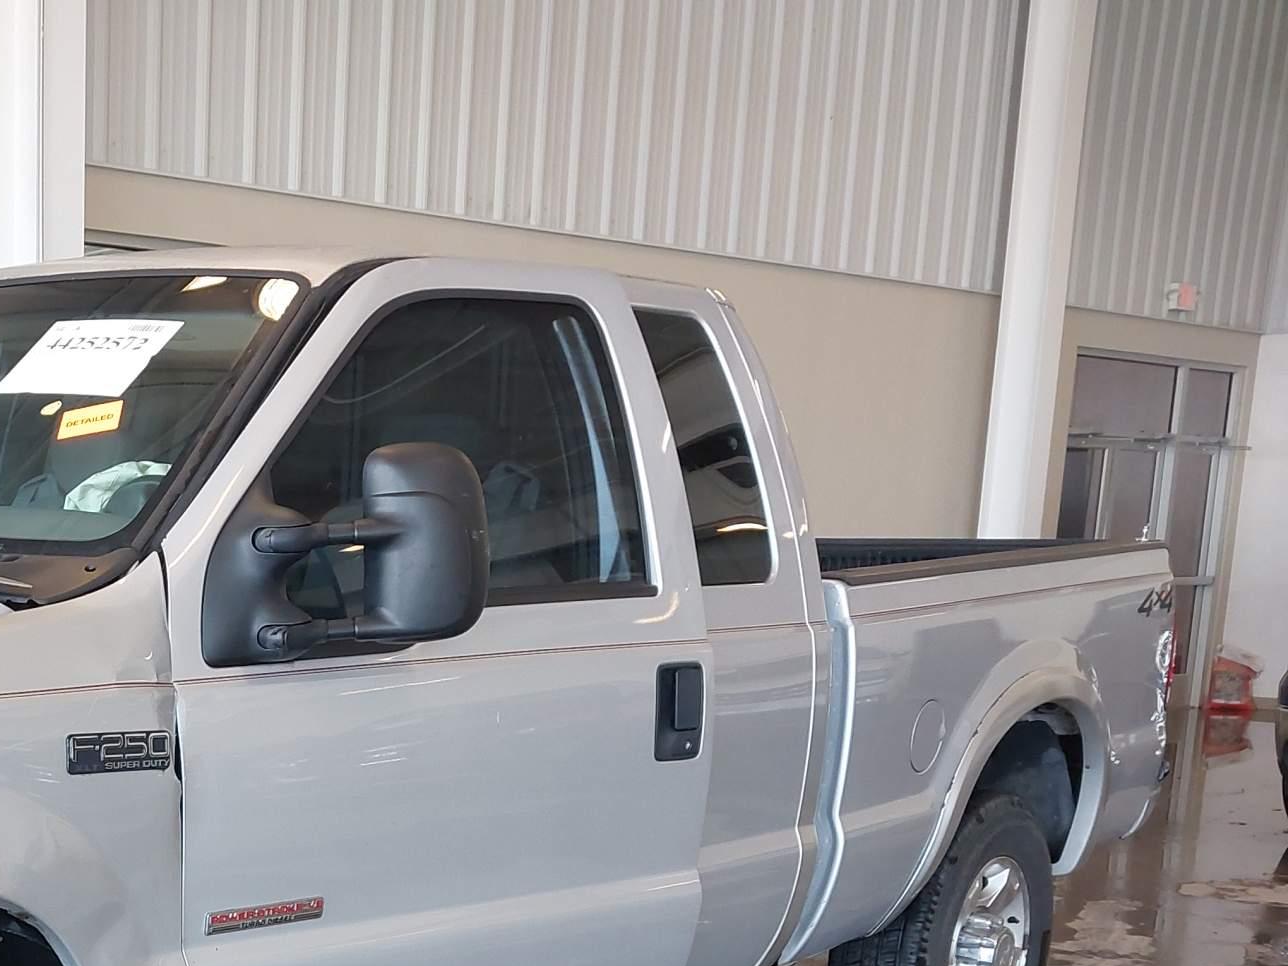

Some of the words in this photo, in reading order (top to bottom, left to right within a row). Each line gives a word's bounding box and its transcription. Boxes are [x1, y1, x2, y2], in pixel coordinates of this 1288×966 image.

[46, 336, 150, 350] 44252572
[65, 413, 114, 428] DETAILED
[70, 732, 170, 762] F-250
[104, 760, 140, 770] SUPER
[142, 758, 169, 768] DUTY
